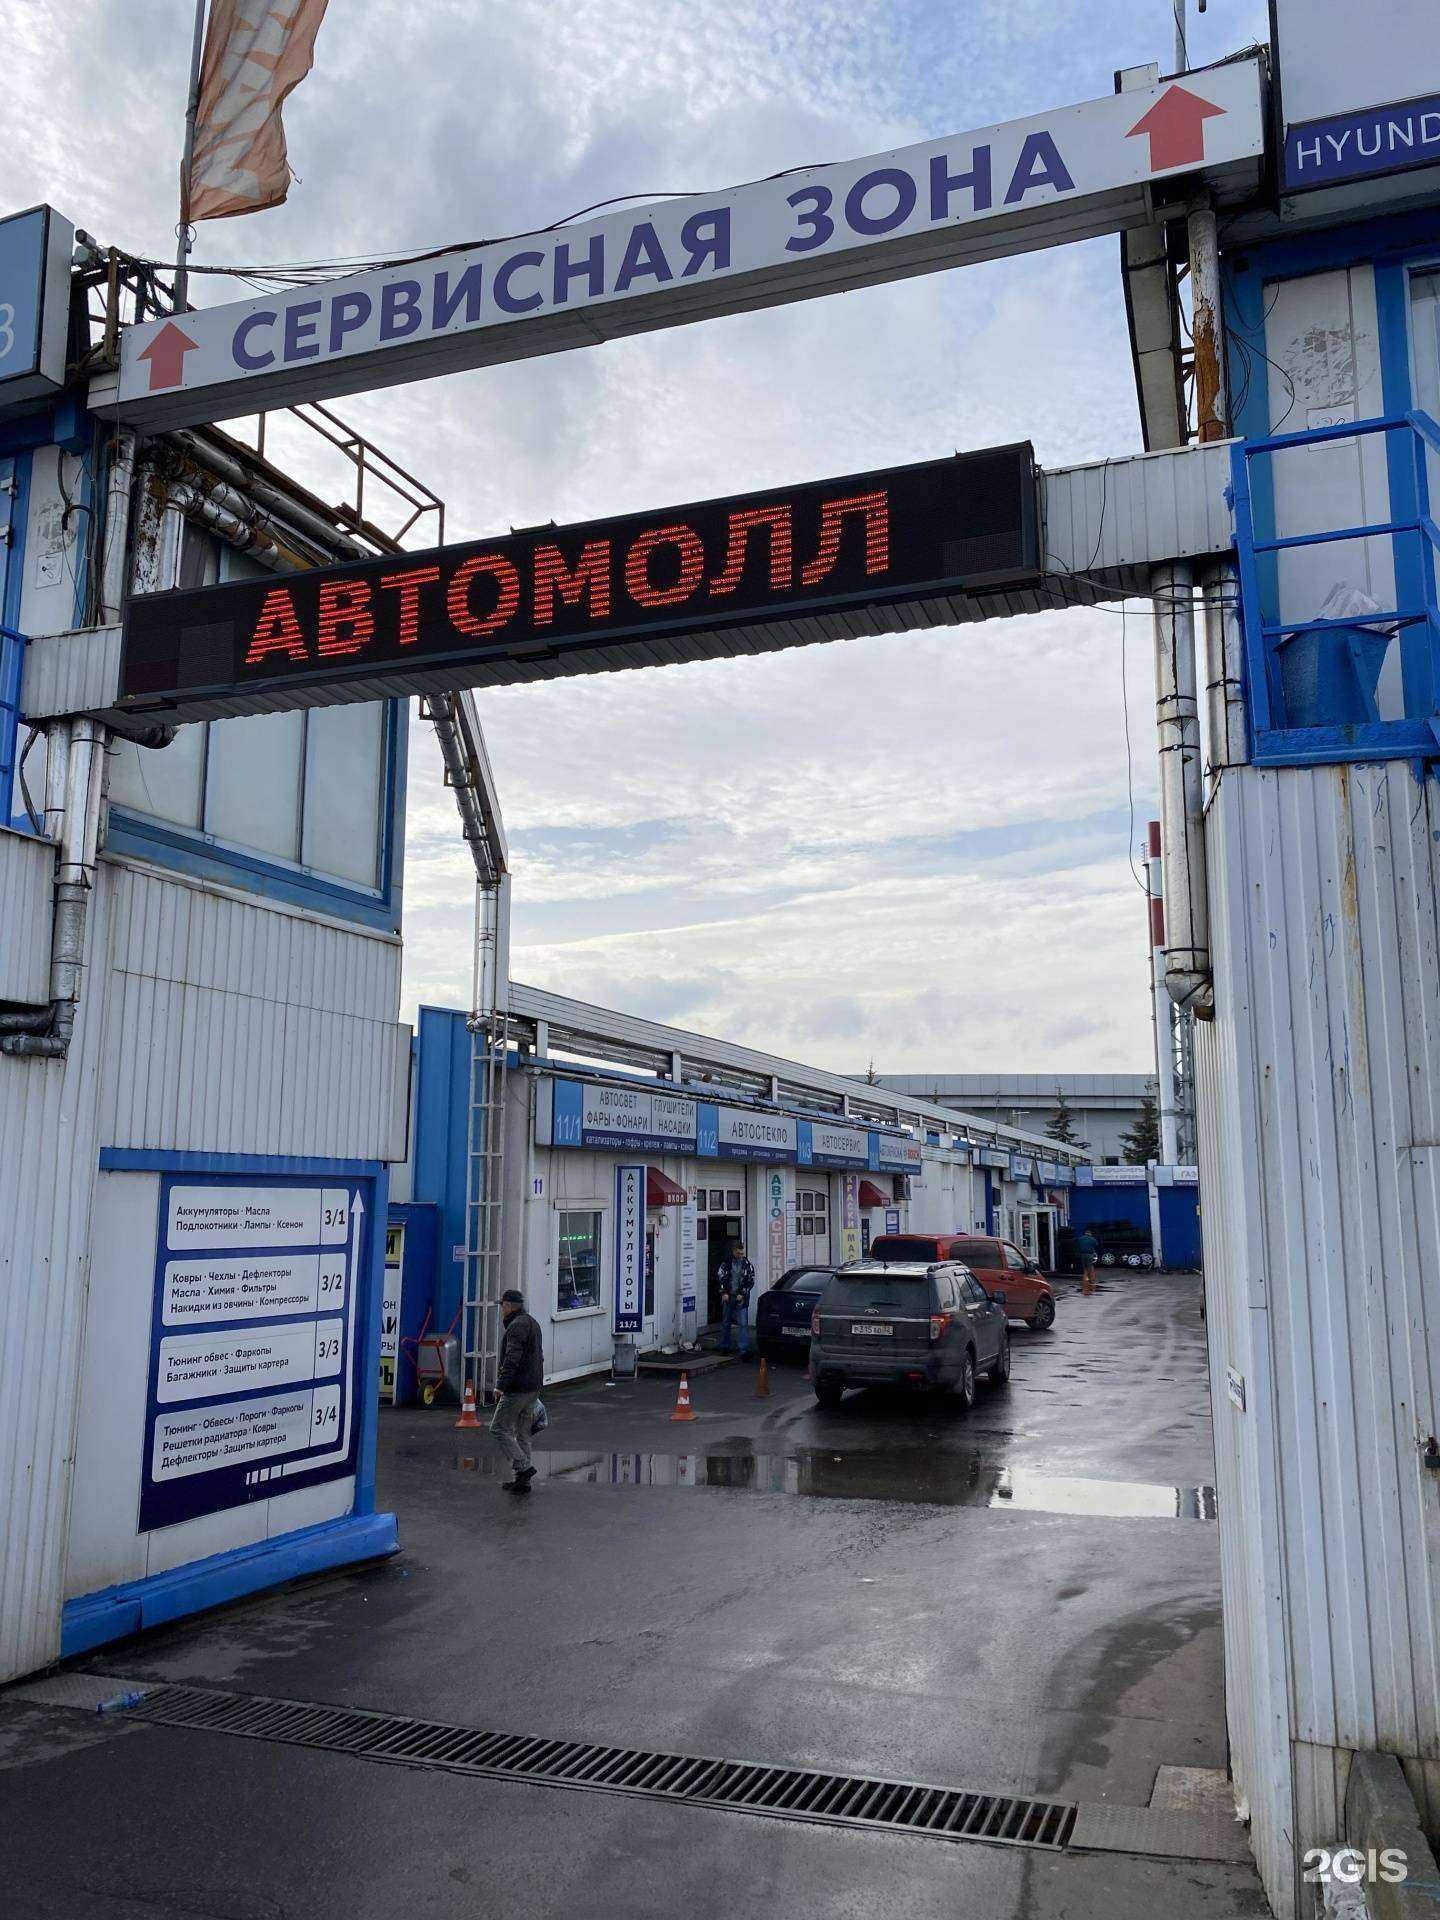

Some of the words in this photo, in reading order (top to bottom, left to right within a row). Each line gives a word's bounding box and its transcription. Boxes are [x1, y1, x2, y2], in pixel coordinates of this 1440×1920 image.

[232, 206, 730, 370] СЕРВИСНАЯ
[786, 131, 1075, 252] ЗОНА
[245, 490, 889, 663] АВТОМОЛЛ
[600, 1091, 638, 1109] АВТОСВЕТ
[655, 1099, 694, 1115] ГЛУШИТЕЛИ
[557, 1114, 580, 1140] 11/1
[587, 1111, 610, 1126] ФАРЫ
[617, 1114, 648, 1130] ФОНАРИ
[659, 1120, 691, 1136] НАСАДКИ
[699, 1130, 716, 1149] 11/2
[732, 1121, 788, 1143] АВТОСТЕКЛО
[822, 1134, 861, 1153] АВТОСЕРВИС
[667, 1193, 685, 1203] ВХОД
[176, 1206, 239, 1217] Аккумуляторы
[245, 1206, 270, 1215] Масла
[325, 1209, 345, 1227] 3/1
[176, 1221, 238, 1231] Подлокотники
[243, 1220, 271, 1229] Лампы
[276, 1219, 303, 1229] Ксенон
[771, 1174, 782, 1282] АВТОСТЕКЛ
[624, 1173, 634, 1310] АККУМУЛЯТОРЫ
[172, 1273, 202, 1284] Ковры
[208, 1271, 236, 1281] Чехлы
[242, 1269, 292, 1280] Дефлекторы
[322, 1274, 342, 1293] 3/2
[171, 1288, 201, 1298] Масла
[208, 1286, 235, 1296] Химия
[241, 1283, 277, 1293] Фильтры
[170, 1303, 211, 1314] Накидки
[223, 1300, 254, 1310] овчины
[259, 1295, 309, 1306] Компрессоры
[619, 1320, 638, 1329] 11/1
[168, 1355, 202, 1367] Тюнинг
[204, 1352, 229, 1362] обвес
[235, 1346, 272, 1358] Фаркопы
[319, 1340, 339, 1358] 3/3
[166, 1369, 217, 1382] Багажники
[223, 1363, 257, 1375] Защиты
[258, 1358, 289, 1370] картера
[163, 1423, 197, 1436] Тюнинг
[203, 1417, 234, 1429] Обвесы
[239, 1411, 267, 1422] Пороги
[271, 1403, 304, 1416] Фаркопы
[315, 1406, 337, 1426] 3/4
[162, 1438, 205, 1451] Решетки
[204, 1429, 248, 1444] радиатора
[252, 1421, 277, 1434] Ковры
[161, 1448, 219, 1469] Дефлекторы
[223, 1442, 256, 1455] Защиты
[256, 1433, 287, 1447] картера
